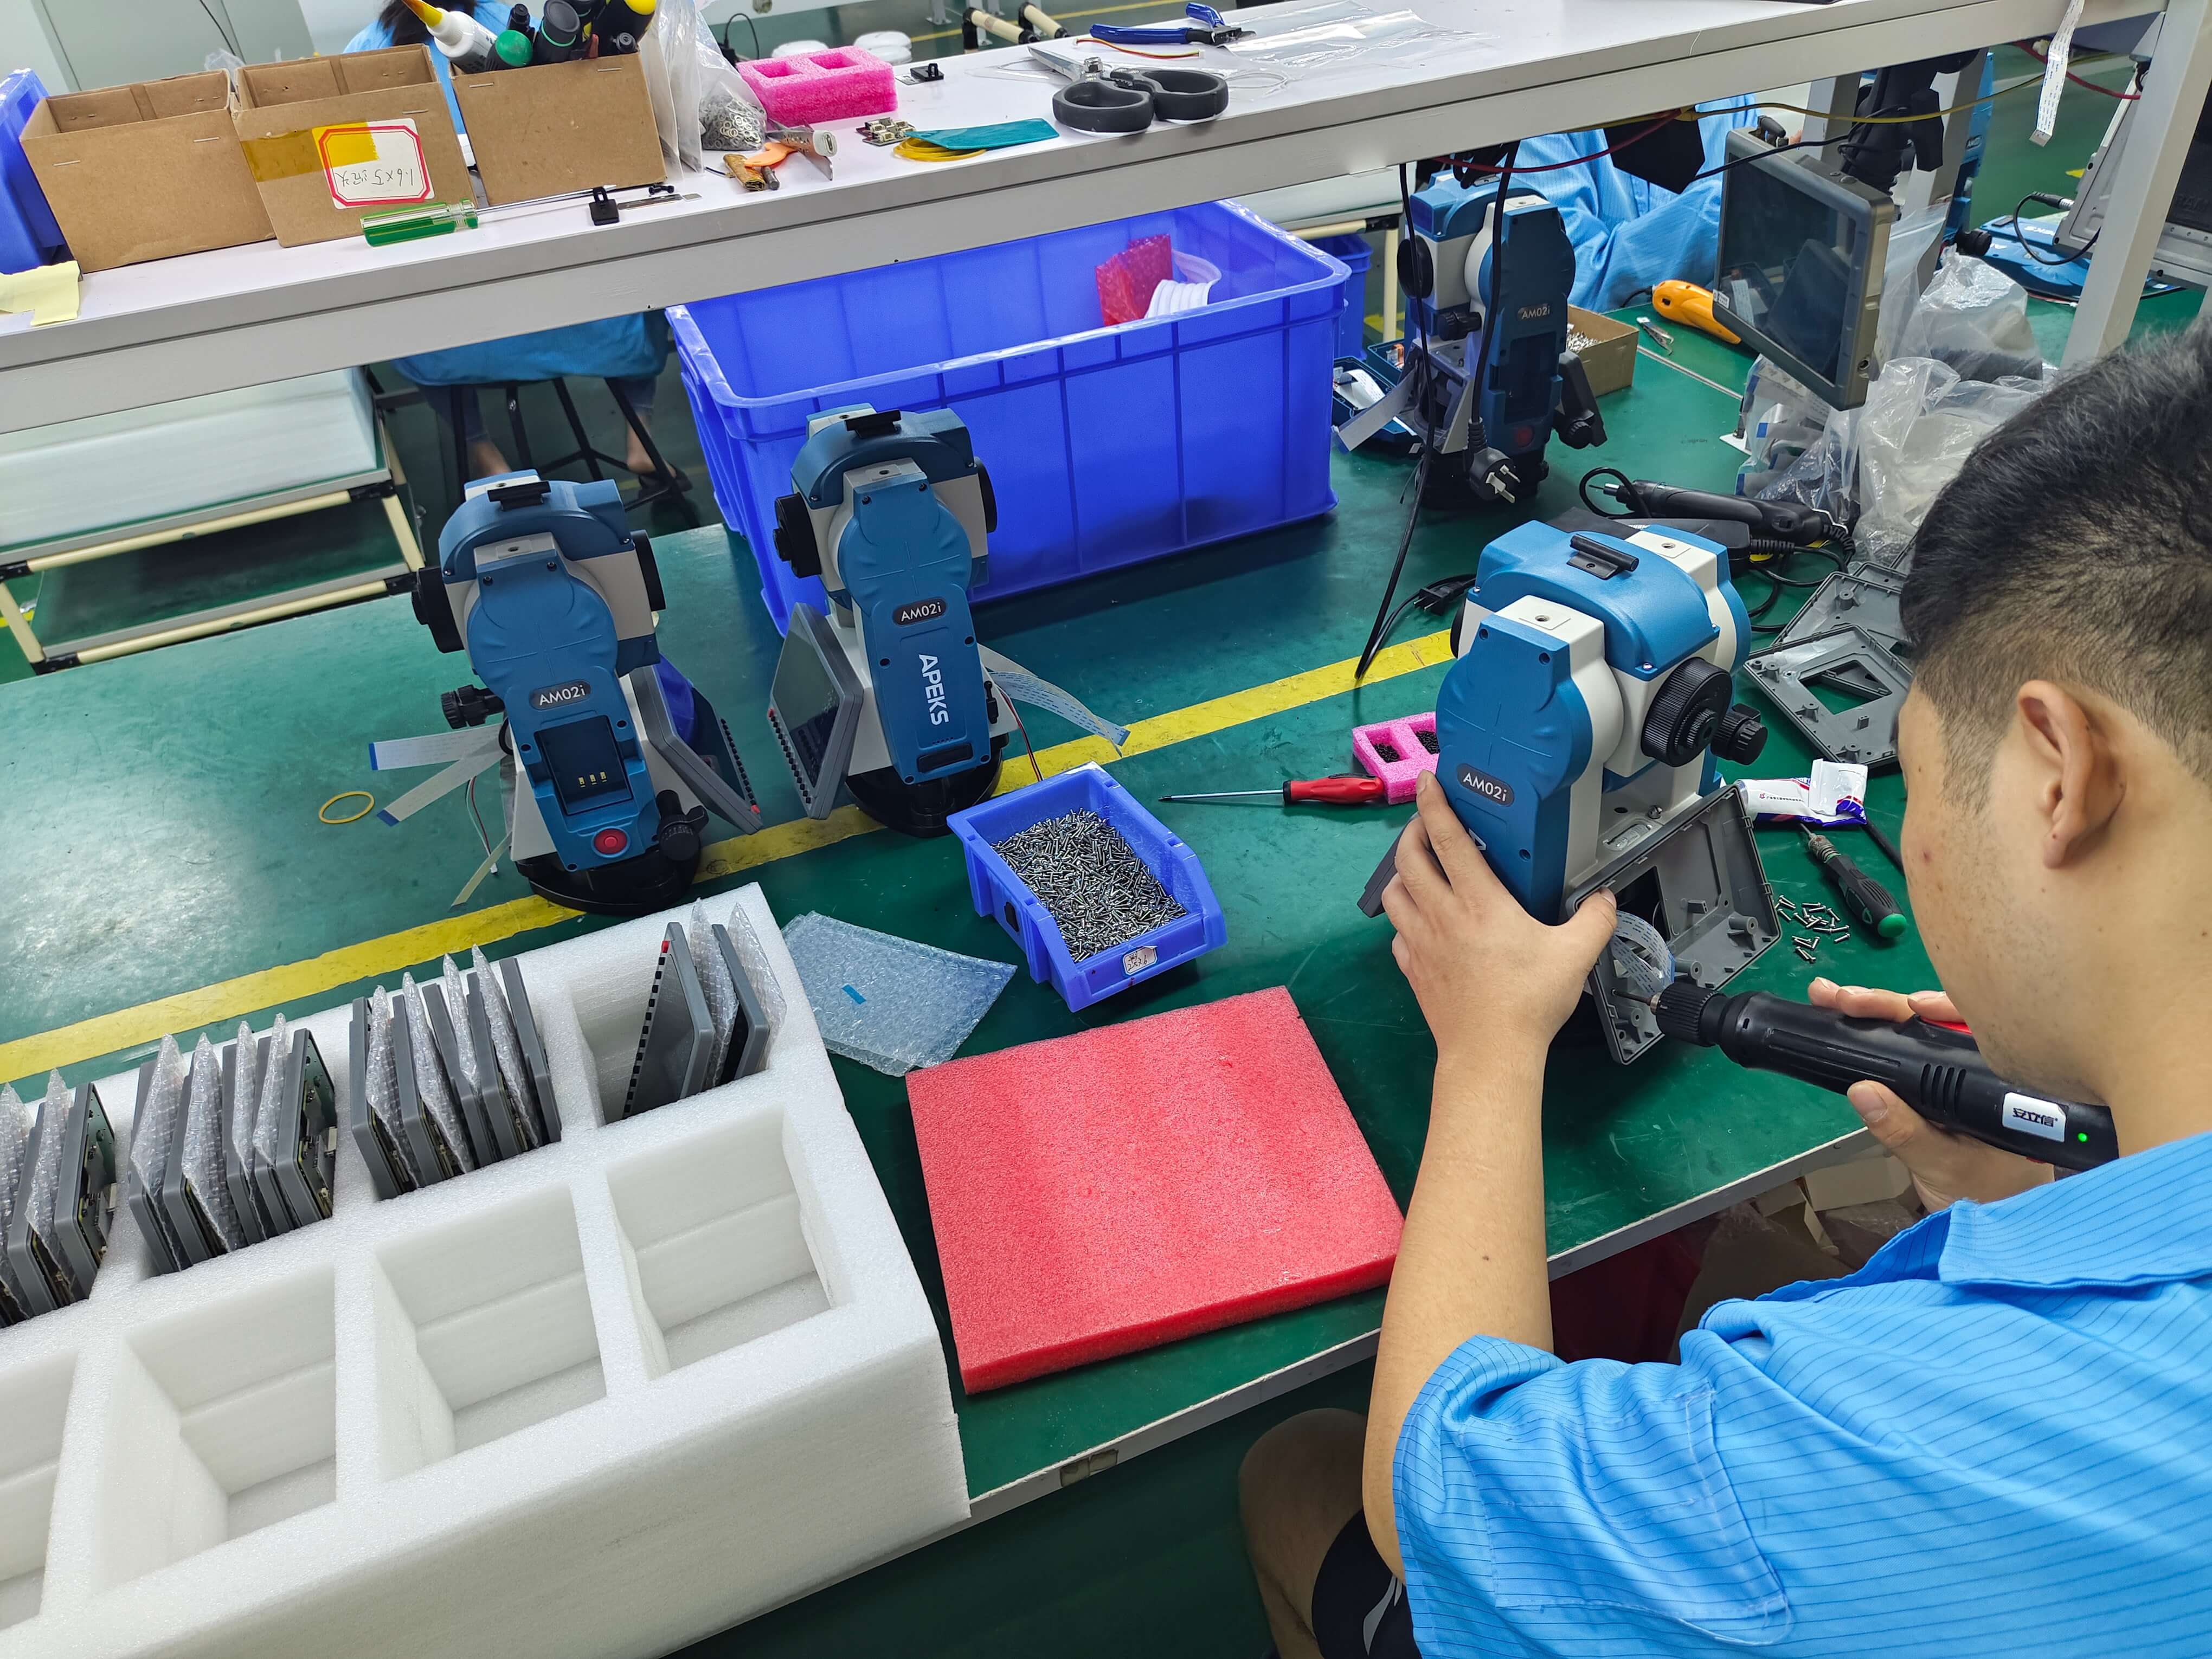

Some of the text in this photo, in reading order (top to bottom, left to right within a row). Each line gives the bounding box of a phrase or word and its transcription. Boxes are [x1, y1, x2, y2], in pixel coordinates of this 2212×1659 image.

[1521, 305, 1550, 319] AM02i
[901, 602, 942, 621] AM02i
[539, 684, 586, 706] AM02i
[918, 654, 949, 725] APEKS
[1463, 772, 1507, 802] AM02i
